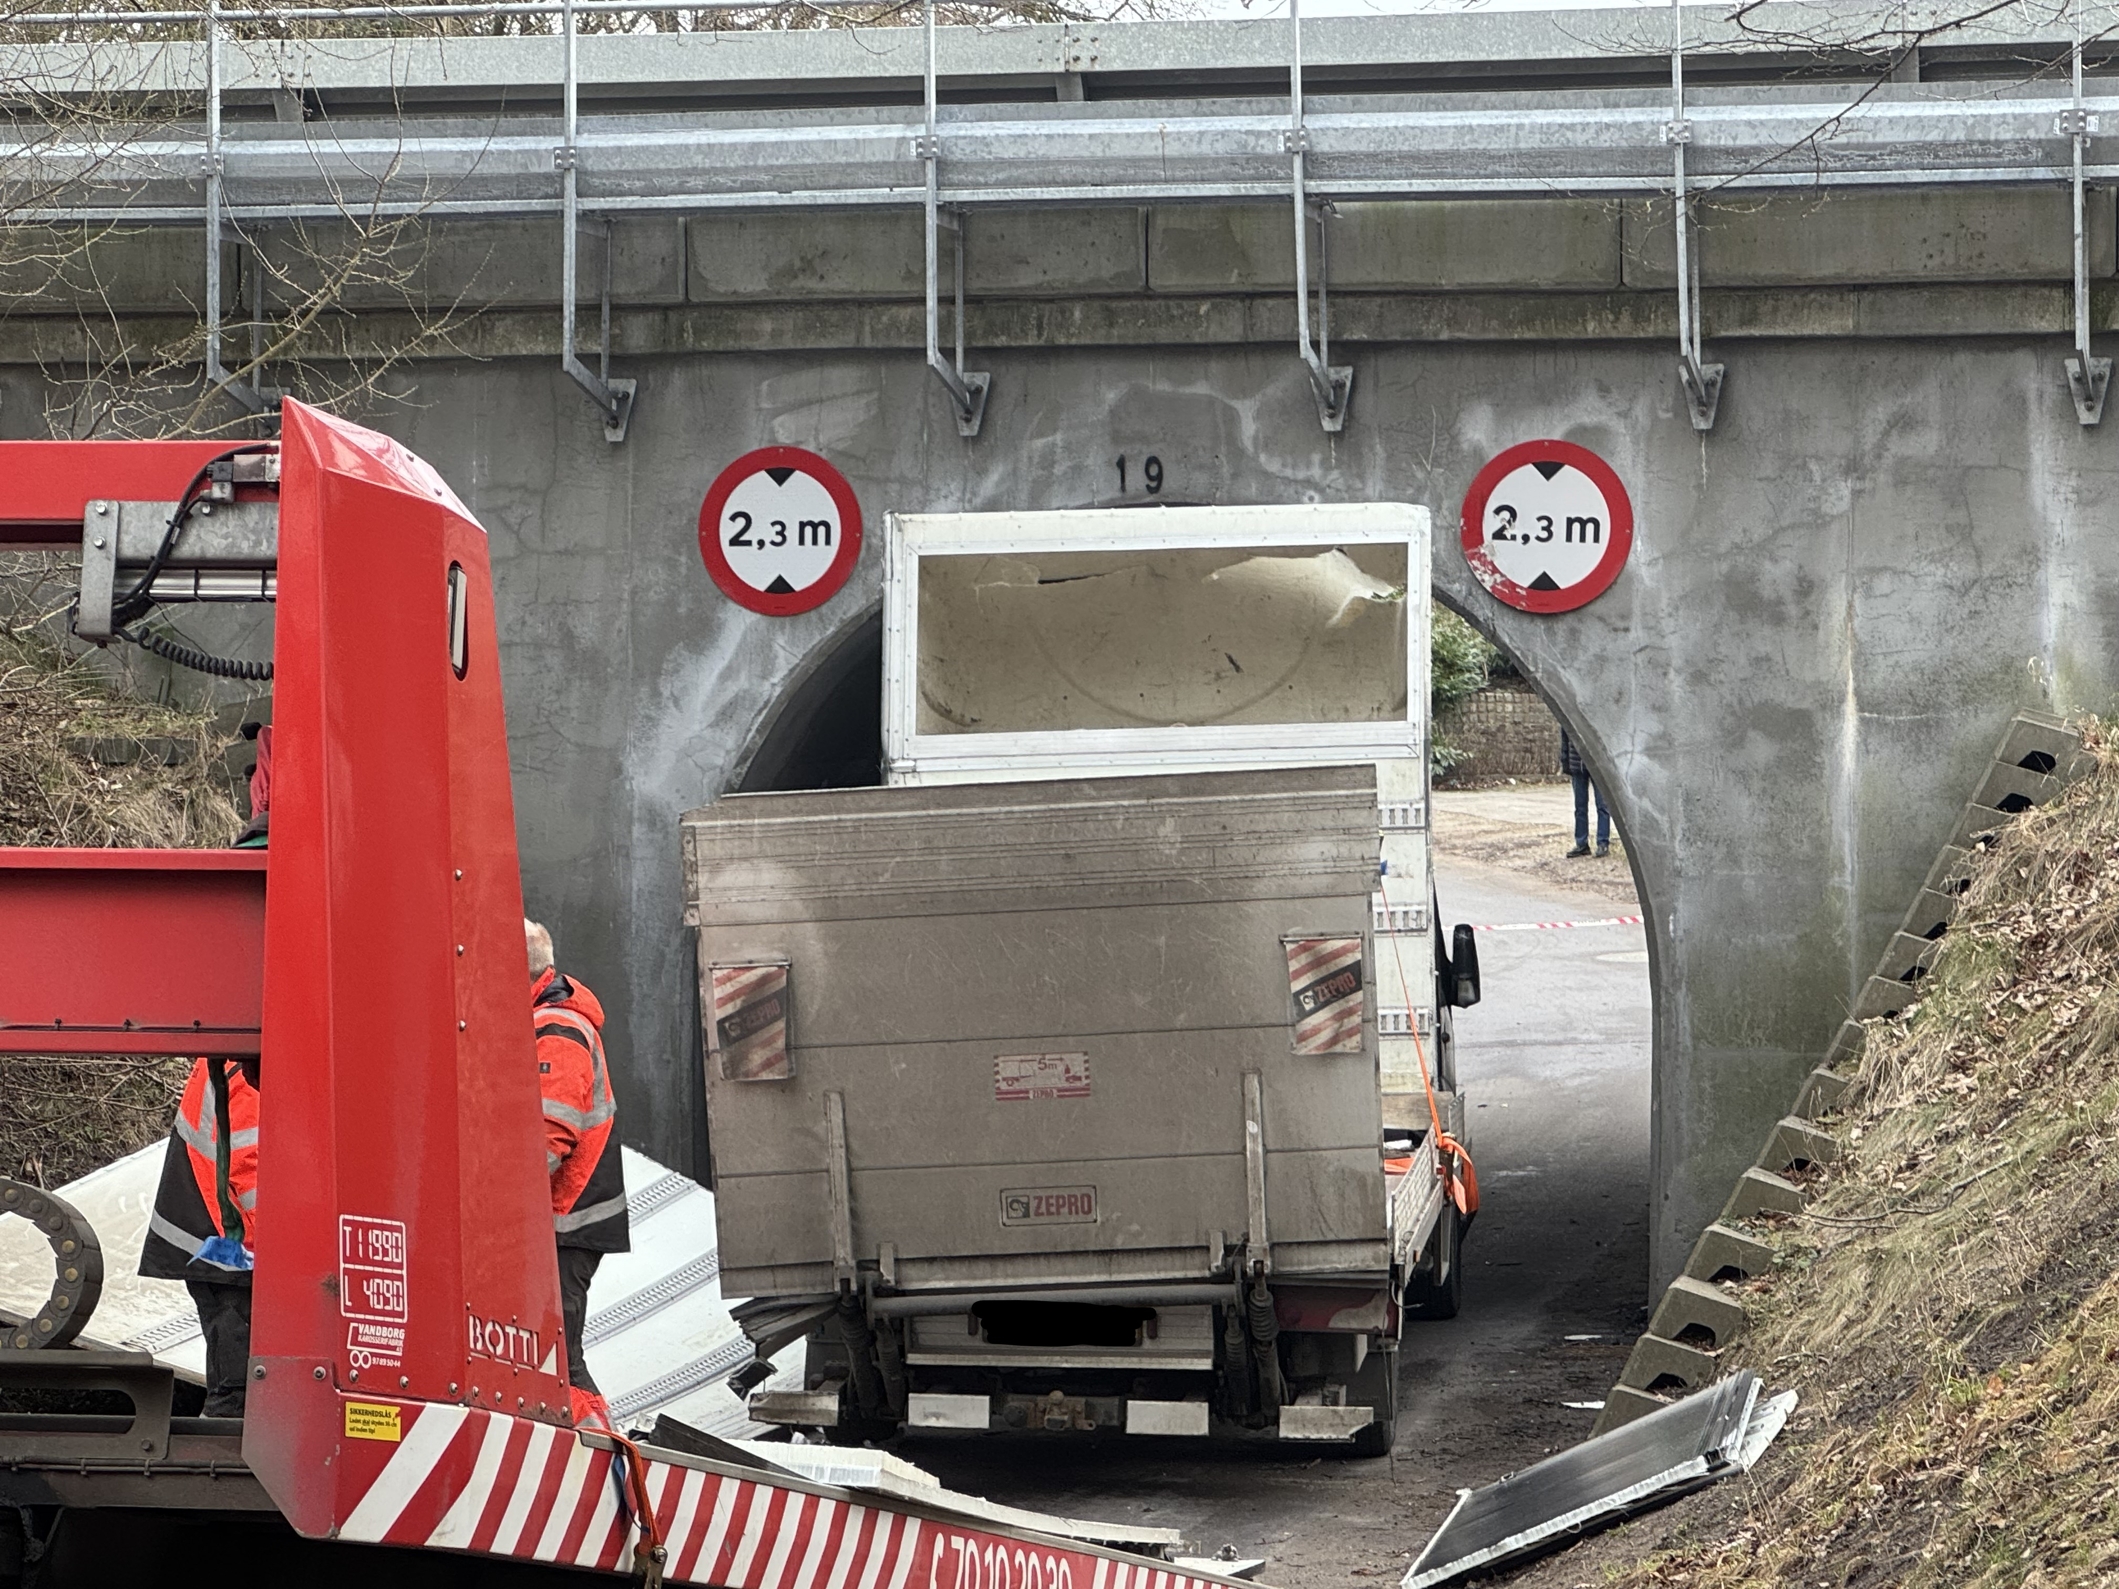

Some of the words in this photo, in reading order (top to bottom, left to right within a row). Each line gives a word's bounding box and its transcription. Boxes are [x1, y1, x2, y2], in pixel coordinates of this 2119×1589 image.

[728, 510, 788, 550] 2,3
[798, 519, 832, 547] m
[1491, 504, 1555, 546] 2,3
[1565, 515, 1601, 544] m
[1314, 971, 1356, 1002] ZEPRO
[1033, 1193, 1093, 1217] ZEPRO
[362, 1278, 403, 1312] 4090
[358, 1323, 405, 1339] VANDBORG
[469, 1314, 539, 1366] BOTTI
